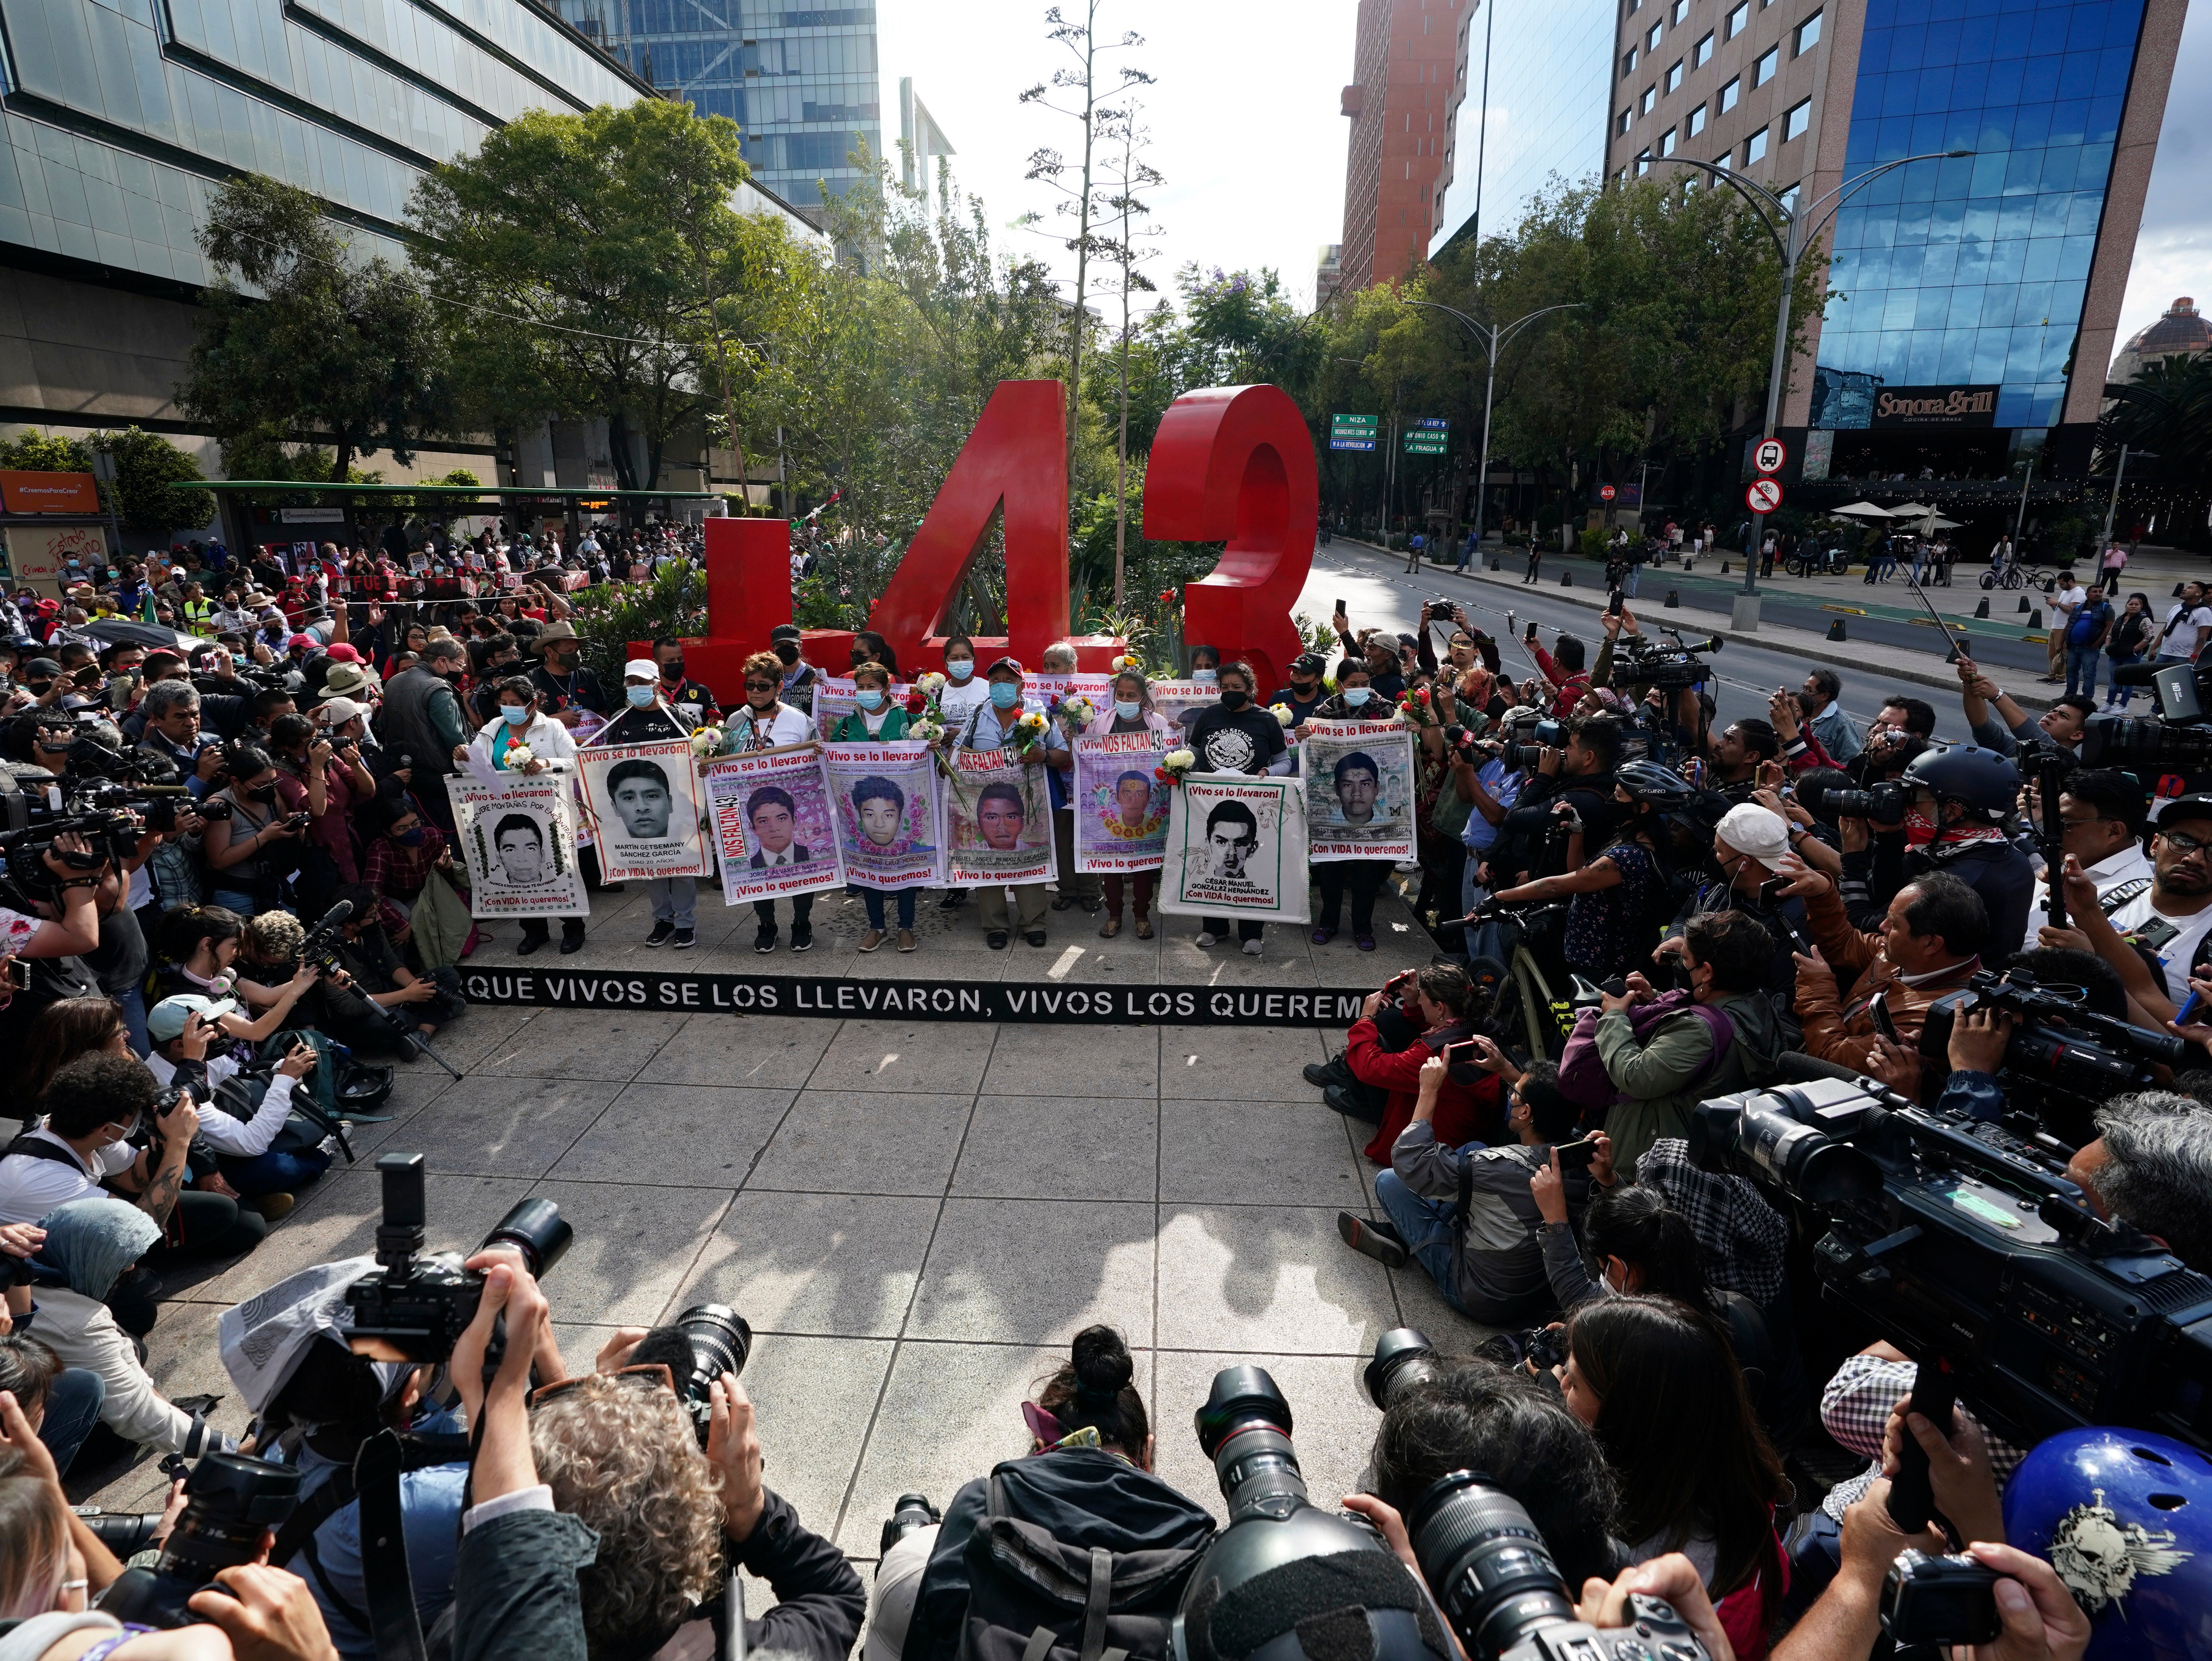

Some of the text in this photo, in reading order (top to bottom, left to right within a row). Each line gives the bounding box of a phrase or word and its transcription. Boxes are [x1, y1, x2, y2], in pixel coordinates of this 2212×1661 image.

[1877, 393, 1945, 417] Sonora
[47, 528, 85, 556] Estado
[821, 686, 844, 696] ¡Vivo
[1055, 681, 1063, 690] lo
[1156, 686, 1177, 696] ¡Vivo
[1193, 686, 1202, 695] lo
[1309, 724, 1330, 736] Vivo
[1347, 726, 1356, 735] lo
[1359, 723, 1405, 735] llevaron!
[1102, 729, 1164, 752] NOS FALTAN 43!
[582, 744, 686, 764] ¡Vivo se lo llevaron!
[825, 750, 850, 762] ¡Vivo
[869, 752, 879, 761] lo
[883, 750, 927, 761] llevaron!
[959, 752, 973, 771] NOS
[973, 749, 1004, 772] FALTAN
[1004, 747, 1017, 768] 43!
[712, 763, 738, 777] ¡Vivo
[741, 762, 754, 771] se
[757, 759, 768, 769] lo
[465, 793, 487, 803] ¡Vivo
[511, 789, 553, 799] llevaron!
[1189, 786, 1211, 796] ¡Vivo
[1226, 788, 1234, 796] lo
[1236, 788, 1279, 799] llevaron!
[472, 804, 491, 825] MOVERE
[492, 801, 527, 810] MONTAÑAS
[530, 801, 544, 810] POR
[544, 807, 576, 850] ENCONTRARTE
[719, 807, 742, 839] FALTAN
[640, 842, 685, 850] GETSEMANY
[724, 838, 745, 858] NOS
[1311, 844, 1408, 855] ¡Con VIDA lo queremos!
[1087, 856, 1163, 870] ¡Vivo lo querem
[609, 864, 700, 878] ¡Con VIDA lo queremos!
[847, 866, 931, 884] ¡Vivo lo queremos!
[954, 866, 1046, 882] ¡Vivo lo queremos!
[737, 884, 763, 898] ¡Vivo
[766, 882, 776, 891] lo
[779, 872, 834, 889] queremos!
[1205, 877, 1227, 886] CÉSAR
[1192, 883, 1269, 895] GONZÁLEZ HERNÁNDEZ
[484, 899, 501, 907] ¡Con
[530, 895, 569, 906] queremos!
[1185, 890, 1203, 899] ¡Con
[1204, 892, 1223, 900] VIDA
[1233, 896, 1274, 904] queremos!
[458, 975, 535, 999] QUE
[545, 977, 646, 1003] VIVOS
[659, 982, 700, 1005] SE
[713, 983, 778, 1008] LOS
[796, 985, 992, 1017] LLEVARON,
[1006, 990, 1113, 1015] VIVOS
[1128, 992, 1195, 1016] LOS
[2071, 1049, 2097, 1061] Panasonic
